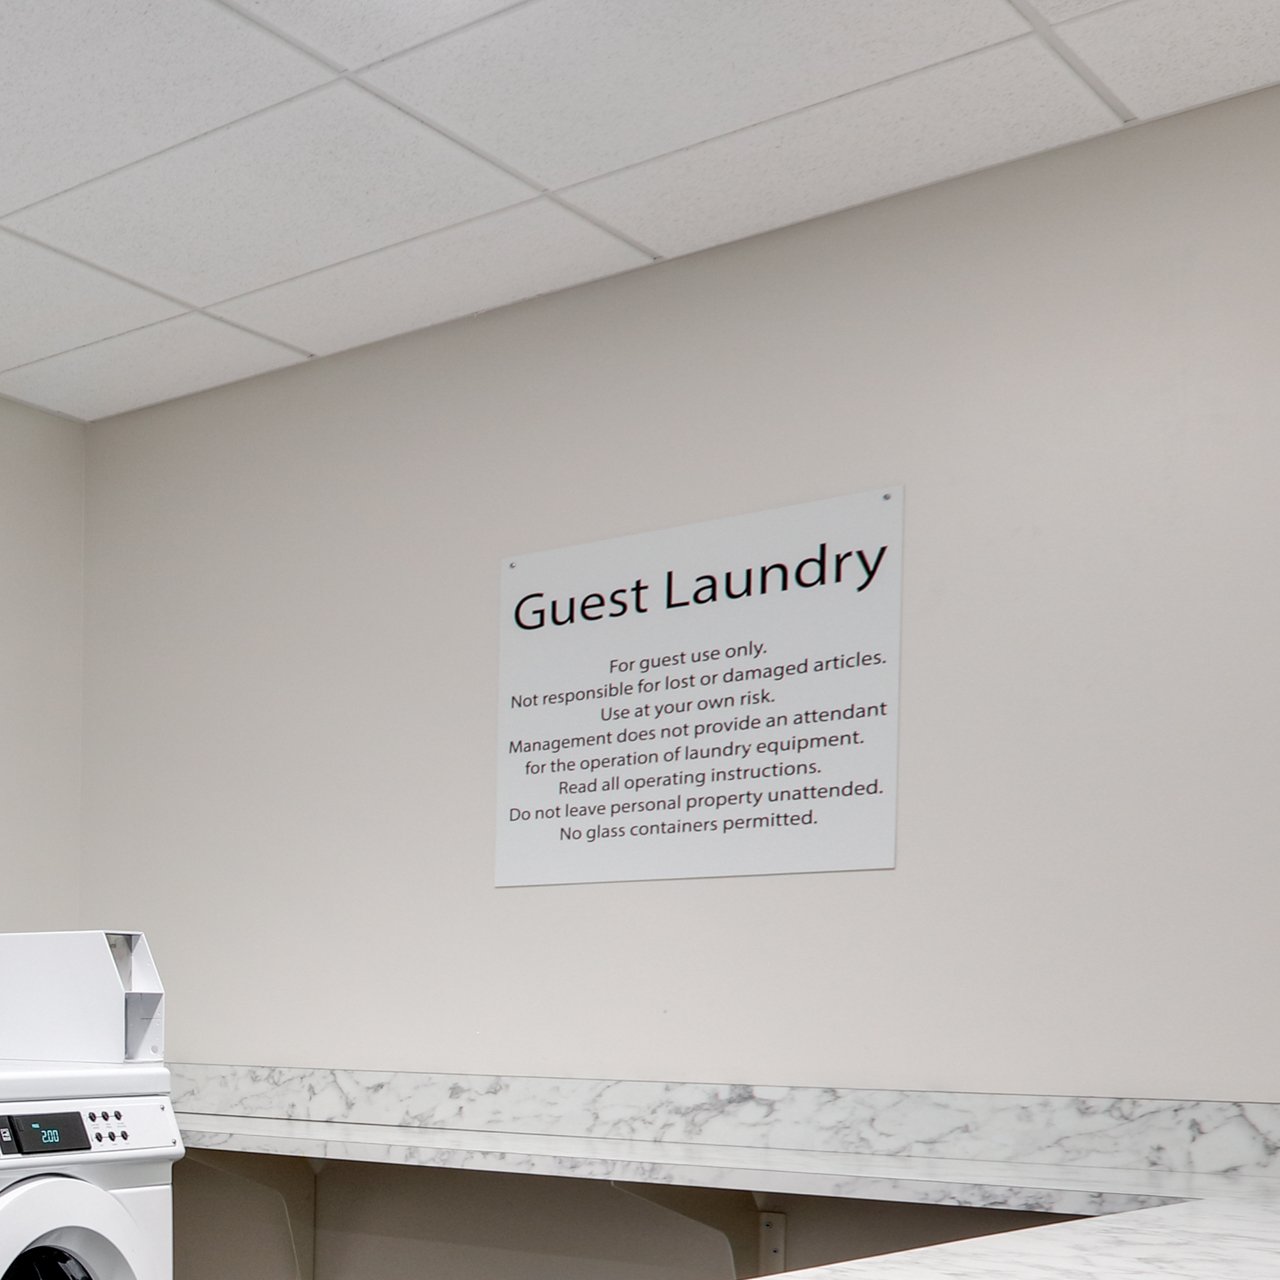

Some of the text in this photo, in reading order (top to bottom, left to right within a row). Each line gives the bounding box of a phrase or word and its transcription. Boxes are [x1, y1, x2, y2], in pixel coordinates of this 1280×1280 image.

[514, 542, 888, 630] Guest Laundry
[610, 640, 767, 674] For guest use only.
[511, 651, 886, 709] Not responsible for lost or damaged articles.
[601, 688, 775, 721] Use at your own risk.
[509, 702, 887, 754] Management does not provide an attendant
[525, 731, 864, 775] for the operation of laundry equipment.
[509, 778, 883, 822] Do not leave personal property unattended.
[559, 762, 821, 795] Read all operating instructions.
[560, 809, 818, 843] No glass containers permitted.
